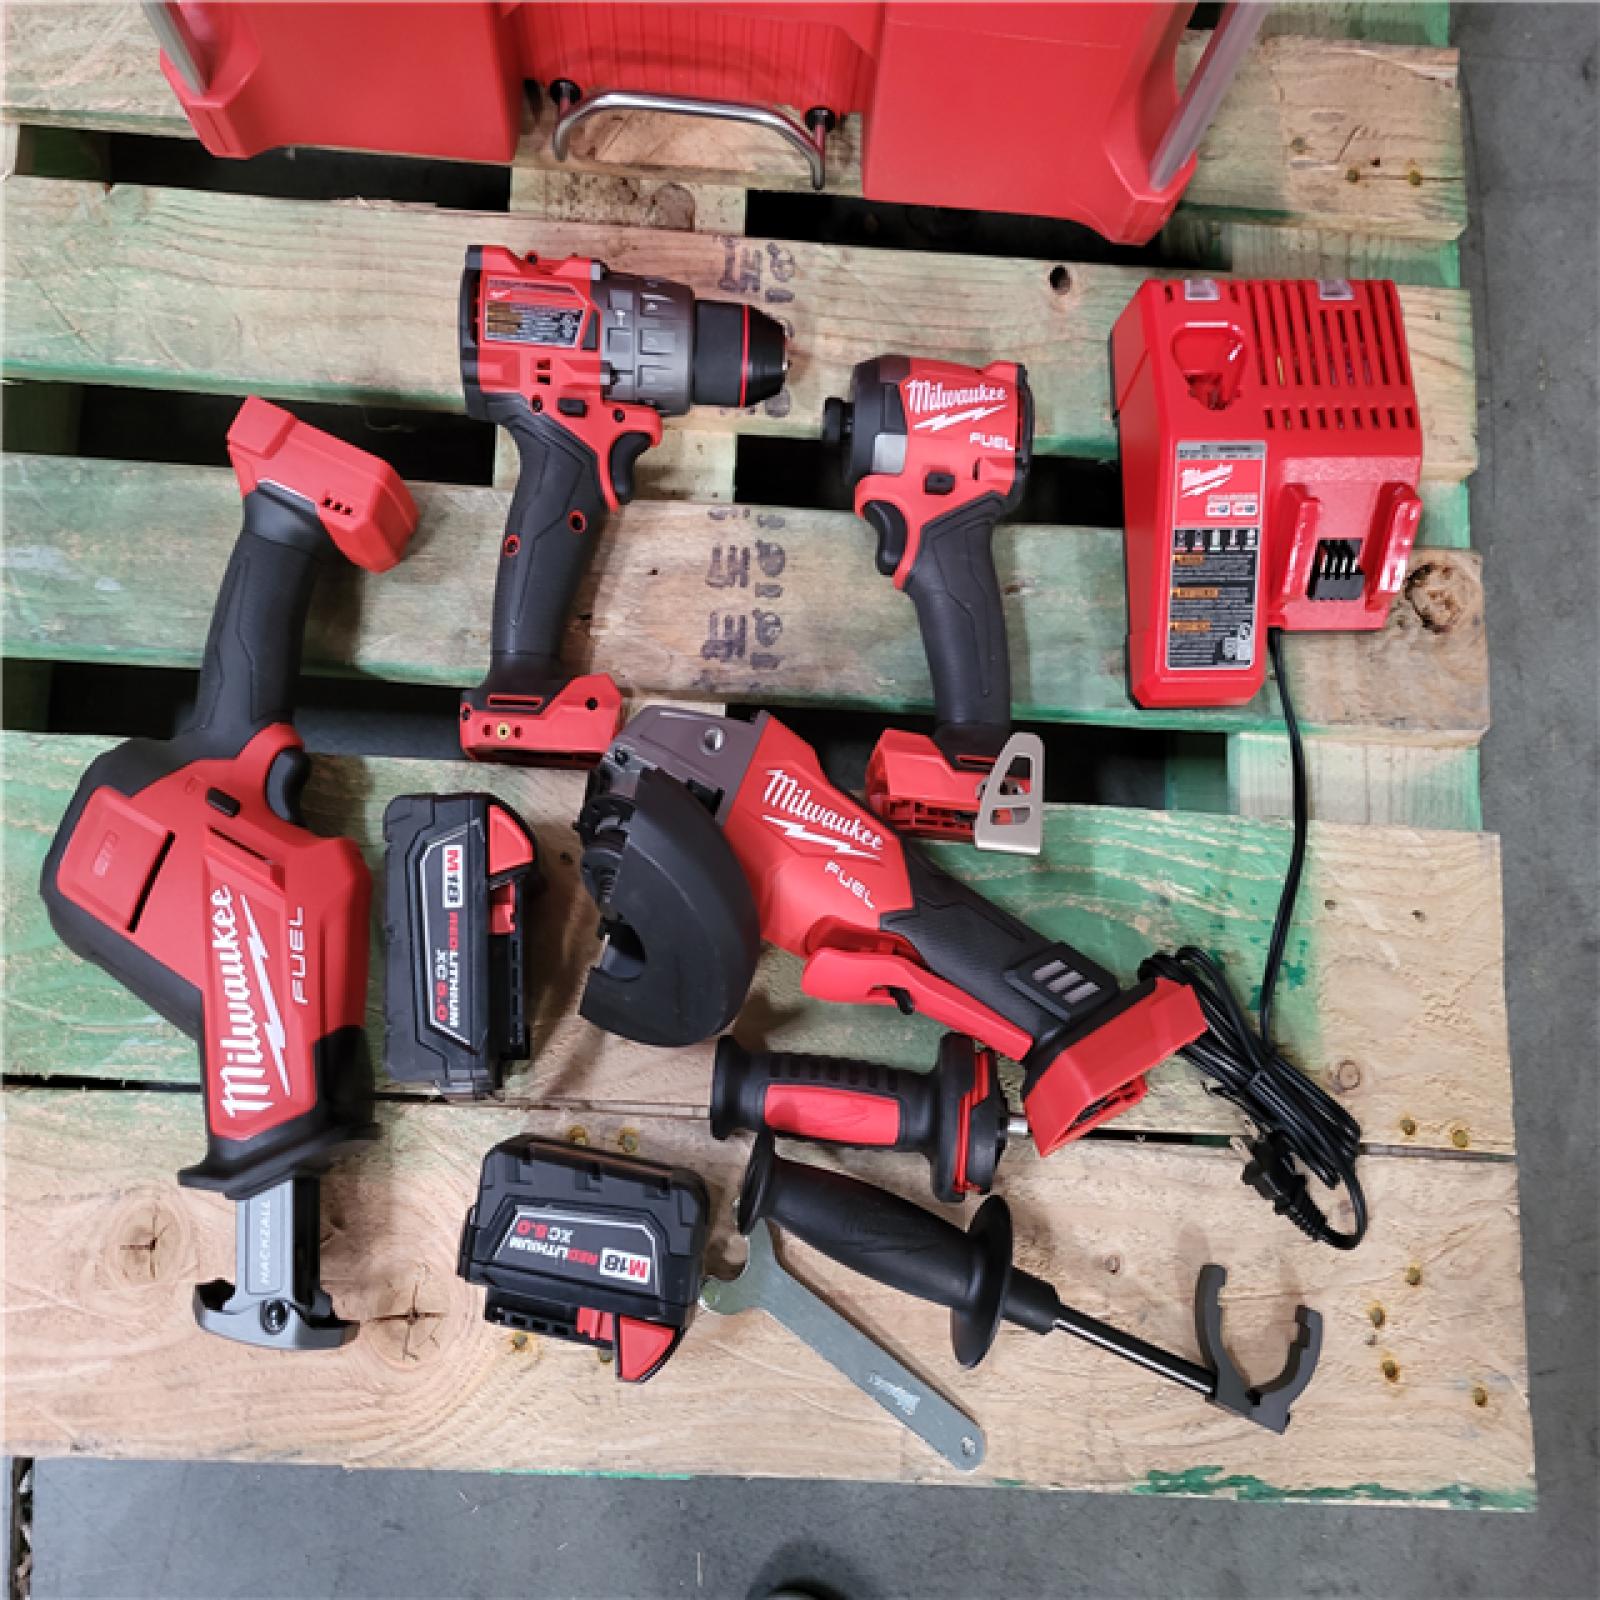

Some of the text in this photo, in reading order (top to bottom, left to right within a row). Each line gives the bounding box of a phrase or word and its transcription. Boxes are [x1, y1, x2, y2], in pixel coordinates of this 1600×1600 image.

[905, 379, 1008, 415] Milwaukee
[969, 432, 1015, 451] FUEL
[763, 768, 884, 850] Milwaukee
[446, 849, 461, 903] M18
[824, 860, 876, 910] FUEL
[288, 906, 309, 1006] FUEL
[210, 884, 275, 1118] Milwaukee
[604, 1254, 649, 1279] M18
